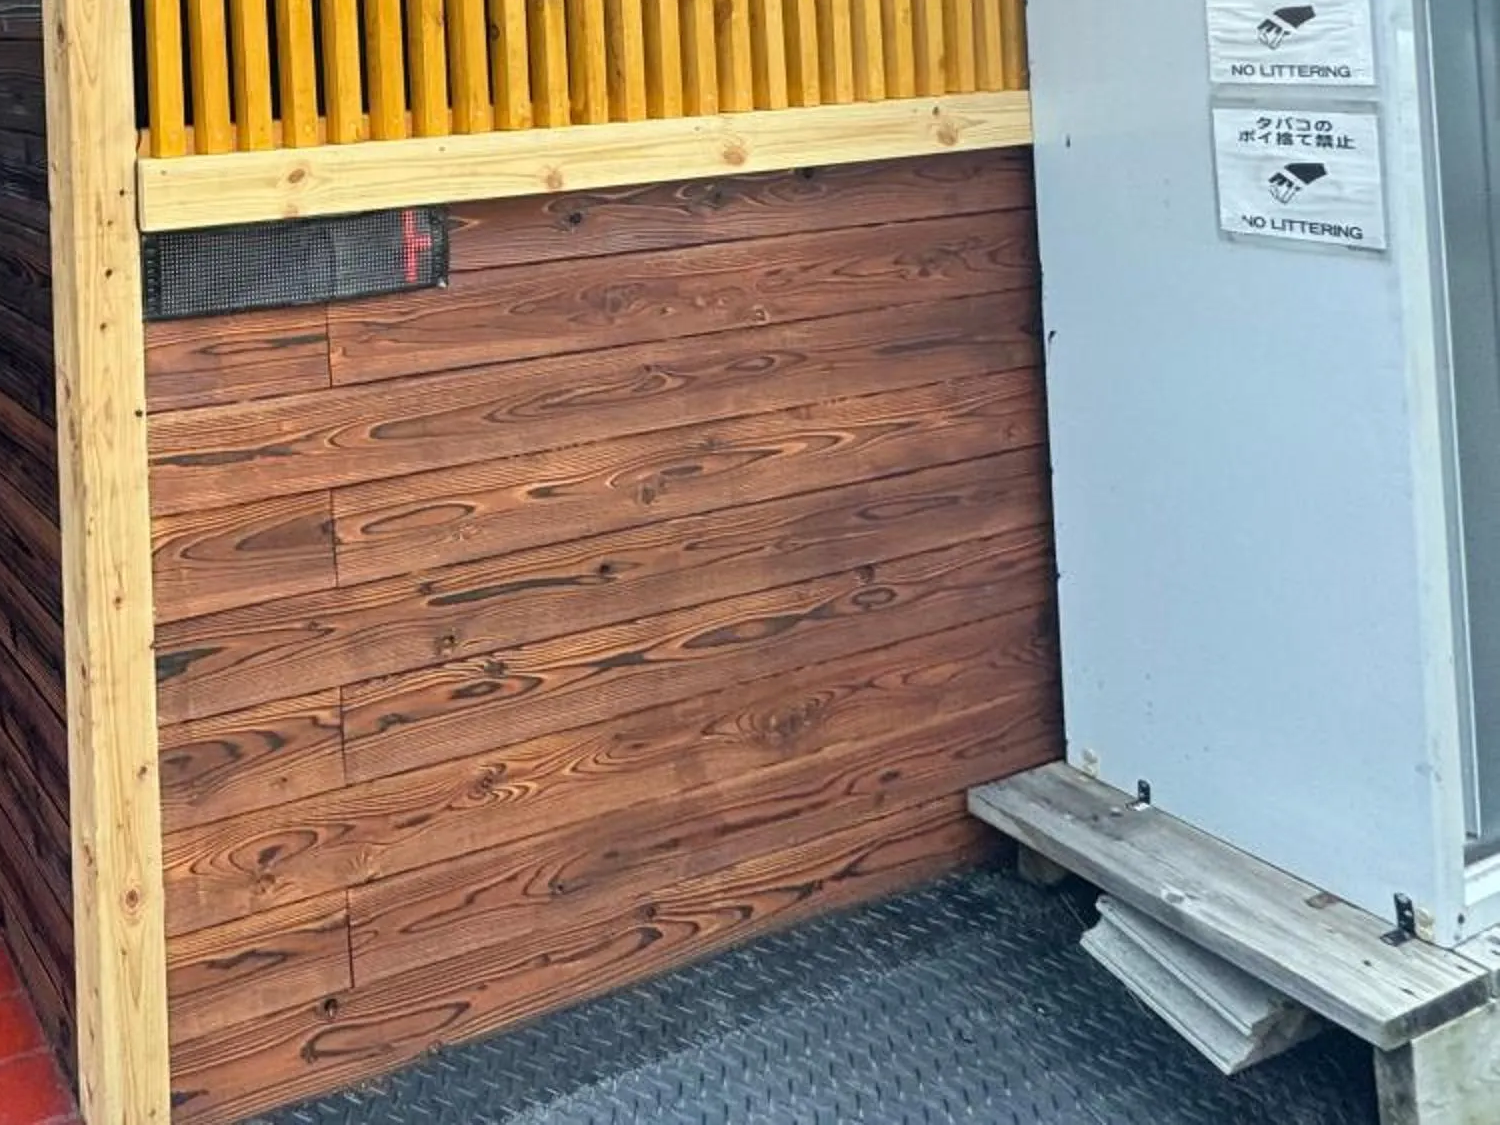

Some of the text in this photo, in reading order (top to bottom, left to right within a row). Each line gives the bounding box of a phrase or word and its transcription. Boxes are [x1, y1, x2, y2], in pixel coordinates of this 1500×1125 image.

[1231, 64, 1352, 78] NO LITTERING
[1256, 116, 1333, 132] タバコの
[1238, 130, 1357, 151] ポイ捨て禁止
[1243, 215, 1363, 240] NO LITTERING
